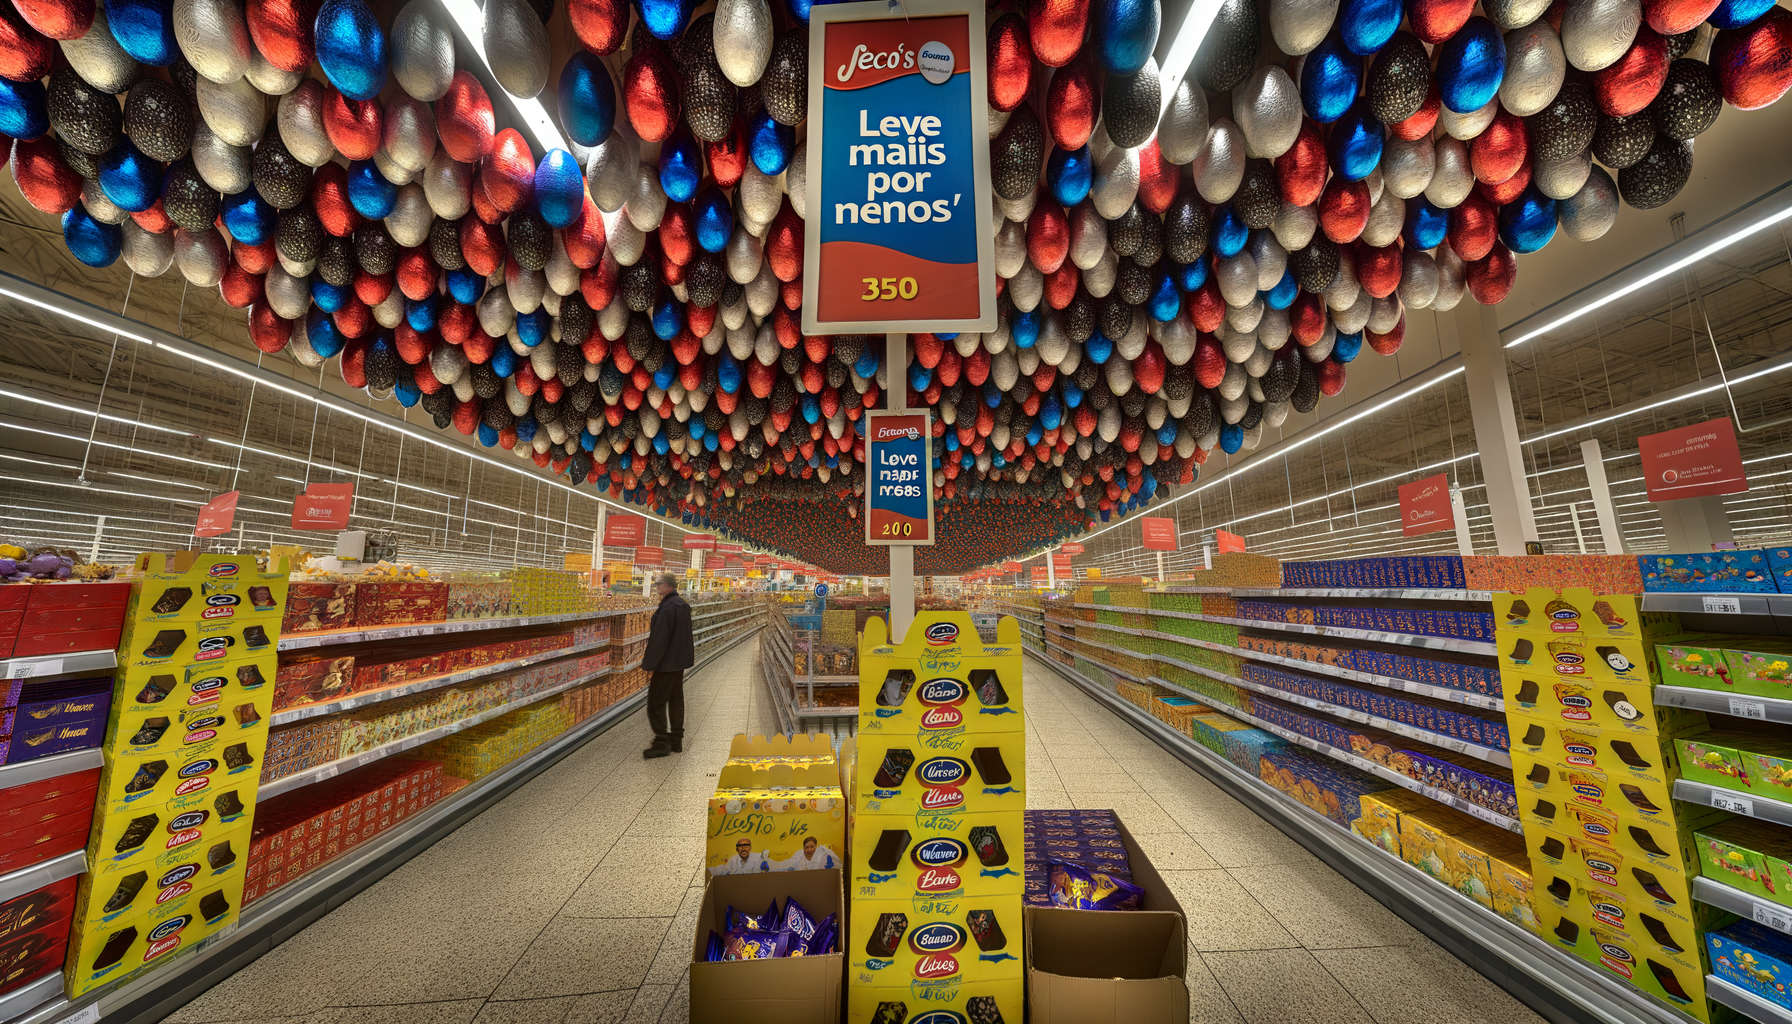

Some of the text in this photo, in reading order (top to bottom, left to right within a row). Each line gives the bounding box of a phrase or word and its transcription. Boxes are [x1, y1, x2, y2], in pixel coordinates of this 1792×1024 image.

[859, 110, 942, 137] Leve
[849, 136, 946, 166] maiis
[867, 171, 931, 201] por
[861, 276, 918, 301] 350
[881, 522, 912, 537] 200
